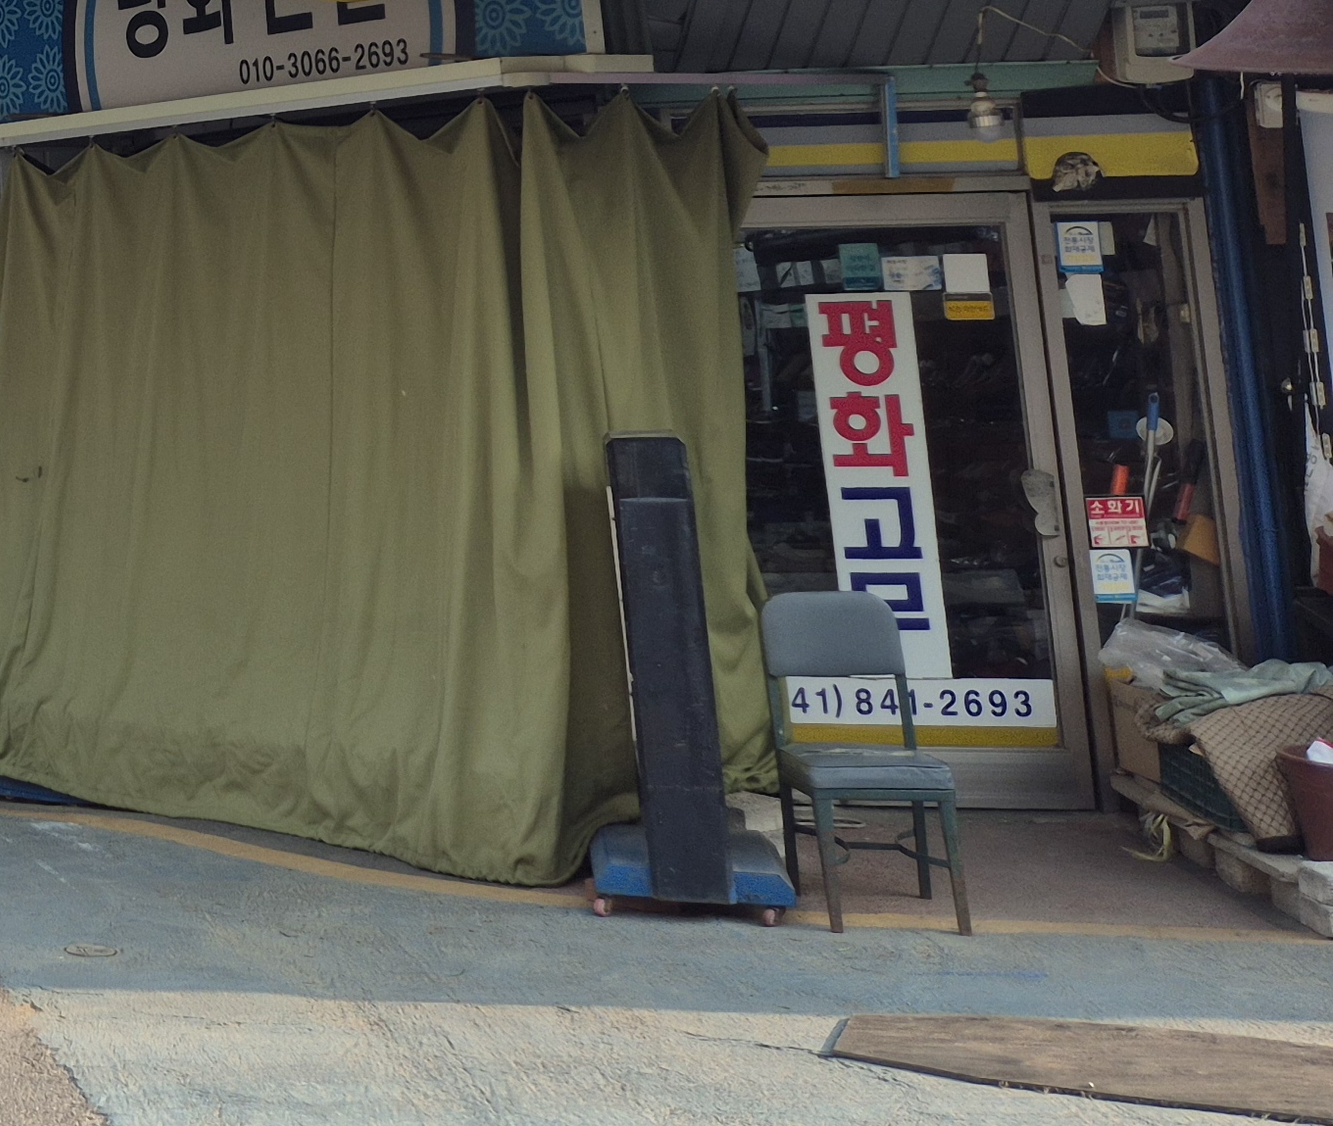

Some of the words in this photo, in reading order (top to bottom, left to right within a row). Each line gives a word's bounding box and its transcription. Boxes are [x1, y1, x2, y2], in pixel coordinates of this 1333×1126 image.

[239, 37, 410, 85] 010-3066-2693
[1090, 499, 1141, 514] 소화기
[855, 687, 1033, 717] 841-2693
